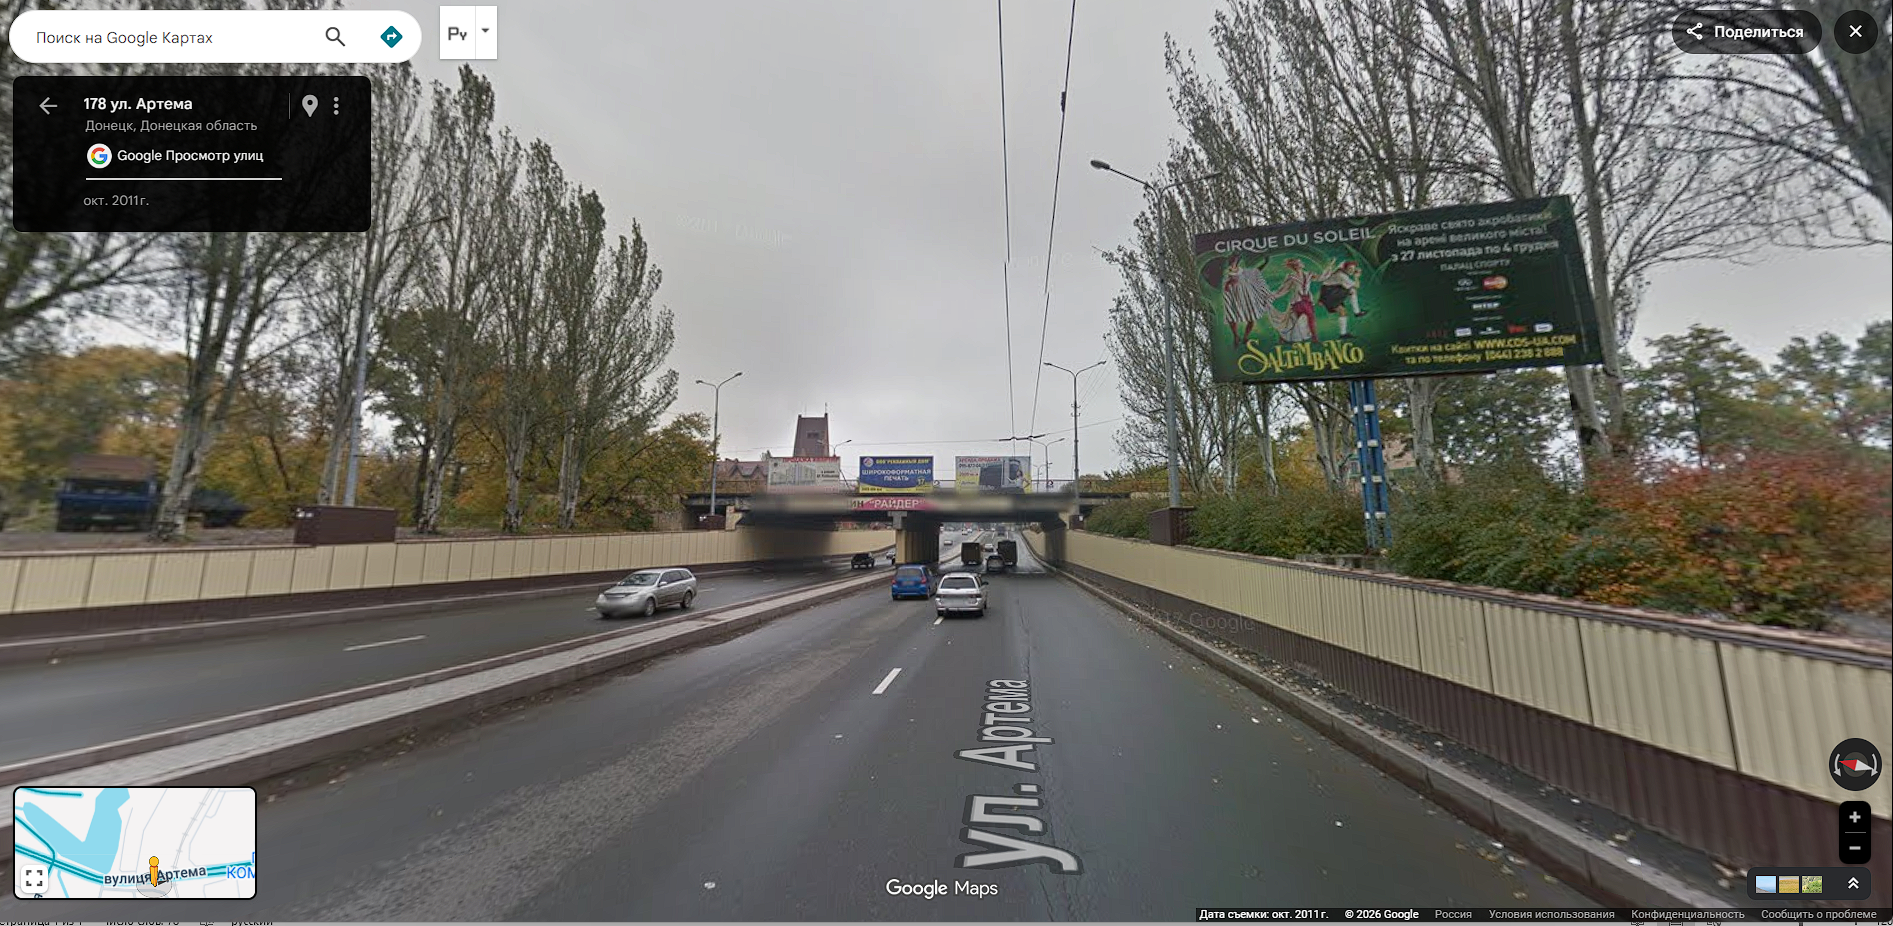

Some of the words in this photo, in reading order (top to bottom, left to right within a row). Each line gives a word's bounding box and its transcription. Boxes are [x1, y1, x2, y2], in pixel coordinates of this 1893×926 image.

[1388, 222, 1438, 235] Яскраве
[1441, 219, 1475, 230] свято
[1397, 237, 1412, 247] на
[1414, 233, 1448, 248] арені
[1449, 229, 1506, 244] великого
[1509, 224, 1548, 237] міста!
[1214, 235, 1279, 253] CIRQUE
[1284, 233, 1309, 247] DU
[1313, 227, 1376, 245] SOLEIL
[1391, 253, 1399, 262] з
[1401, 251, 1415, 261] 27
[1416, 245, 1483, 260] листопада
[1485, 245, 1501, 254] по
[1502, 243, 1512, 253] 4
[1512, 239, 1559, 255] грудня
[1391, 343, 1429, 354] Квитки
[1430, 343, 1443, 352] на
